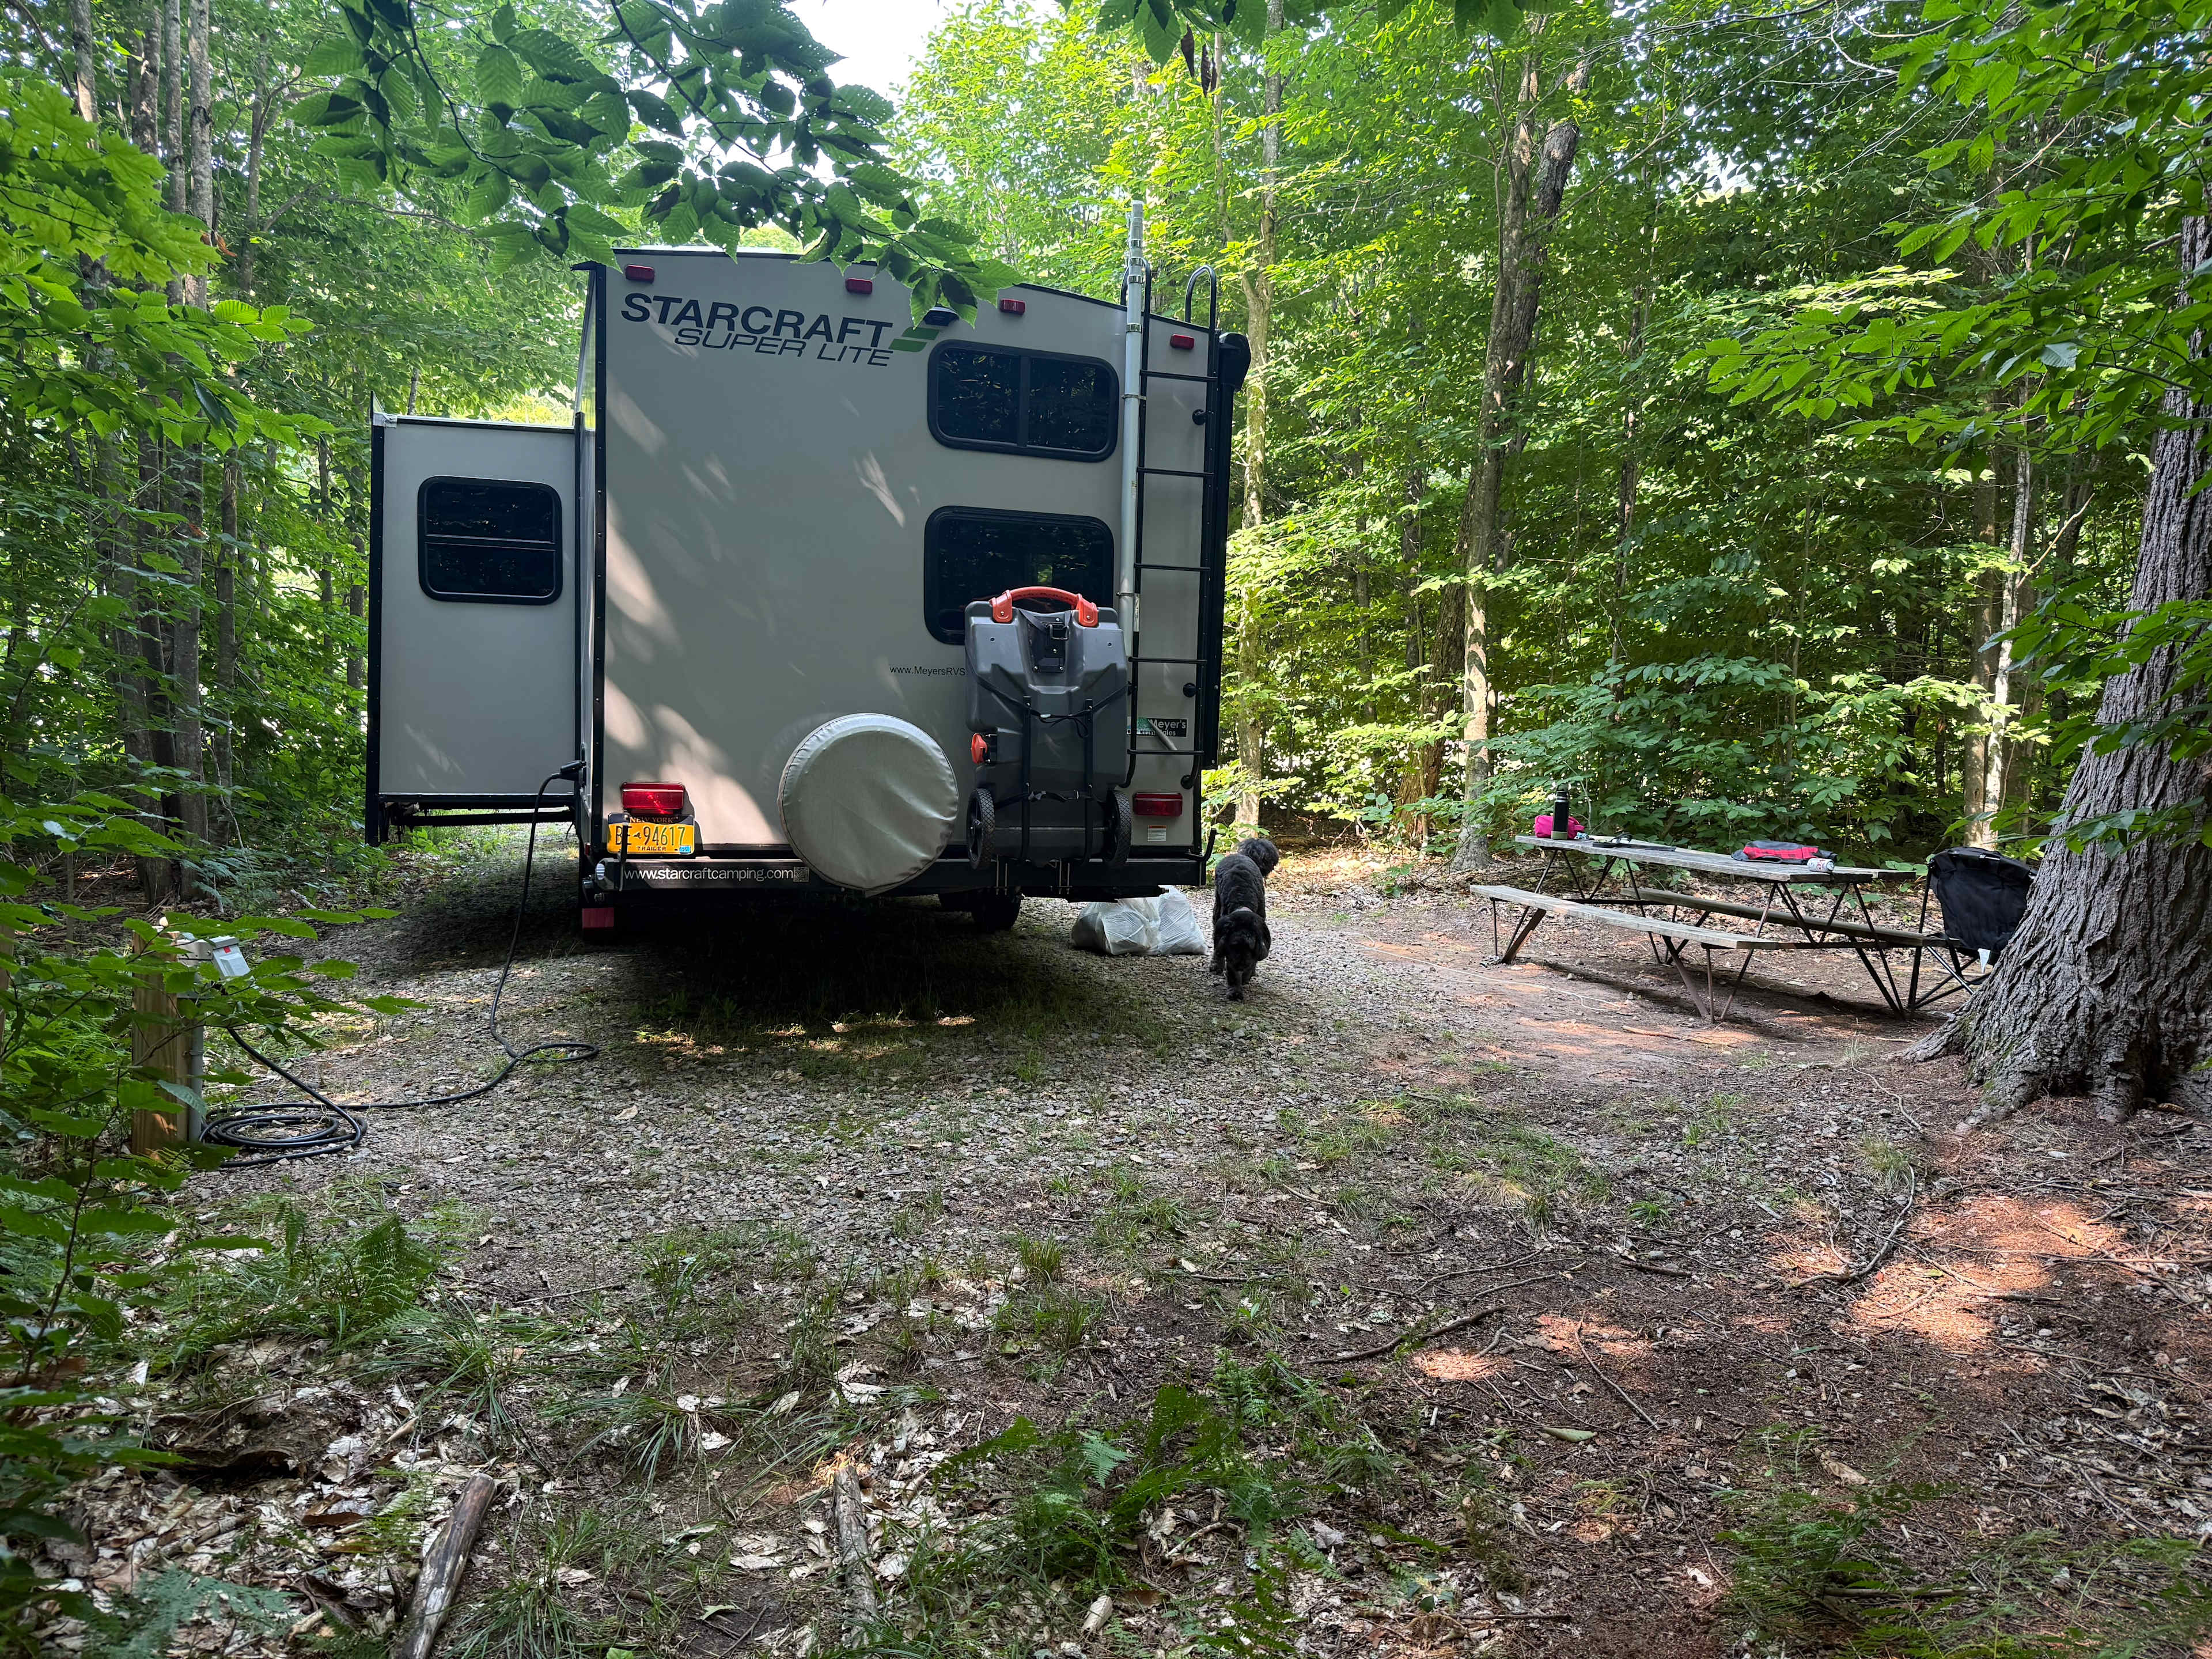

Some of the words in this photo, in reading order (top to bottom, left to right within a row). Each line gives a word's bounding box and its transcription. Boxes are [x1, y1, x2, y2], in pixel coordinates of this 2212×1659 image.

[620, 293, 893, 347] STARCRAFT
[673, 328, 807, 357] SUPER
[816, 343, 894, 367] LITE
[643, 826, 685, 846] 94617
[624, 867, 794, 881] www.starcraftcamping.com
